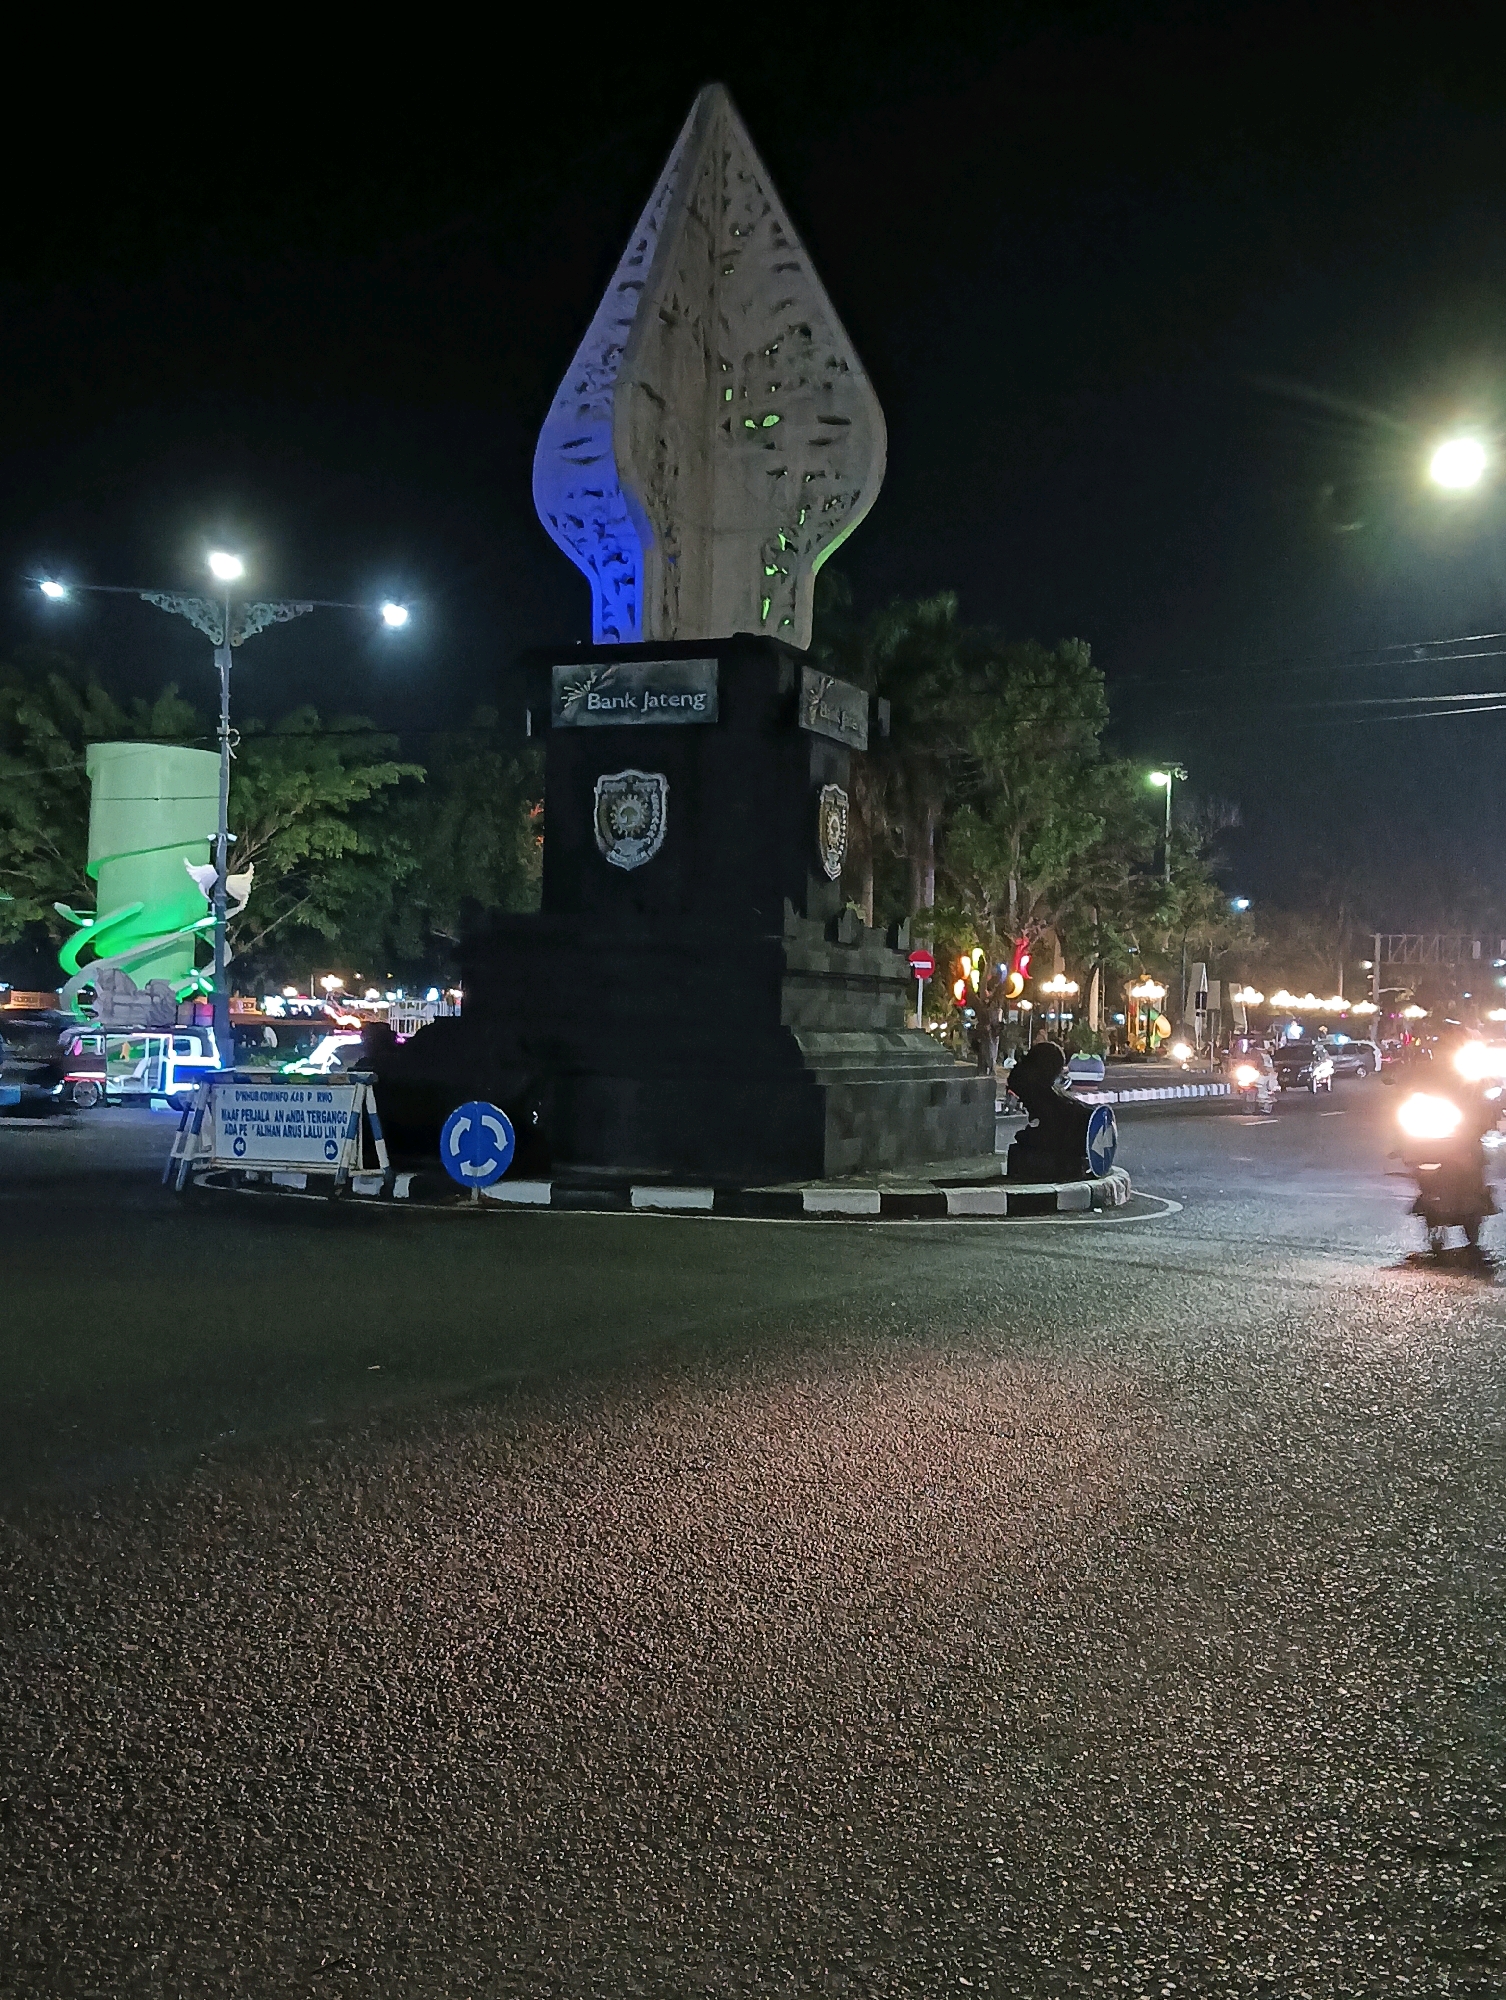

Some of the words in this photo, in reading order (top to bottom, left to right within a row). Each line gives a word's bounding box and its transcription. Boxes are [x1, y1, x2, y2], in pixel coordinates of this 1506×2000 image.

[587, 690, 636, 711] Bank
[641, 690, 707, 713] Jateng
[241, 1109, 284, 1123] PERJALAAN
[306, 1110, 348, 1125] TERGANGG
[224, 1123, 238, 1136] ADA
[283, 1124, 302, 1139] ARUS
[303, 1125, 323, 1139] LALU
